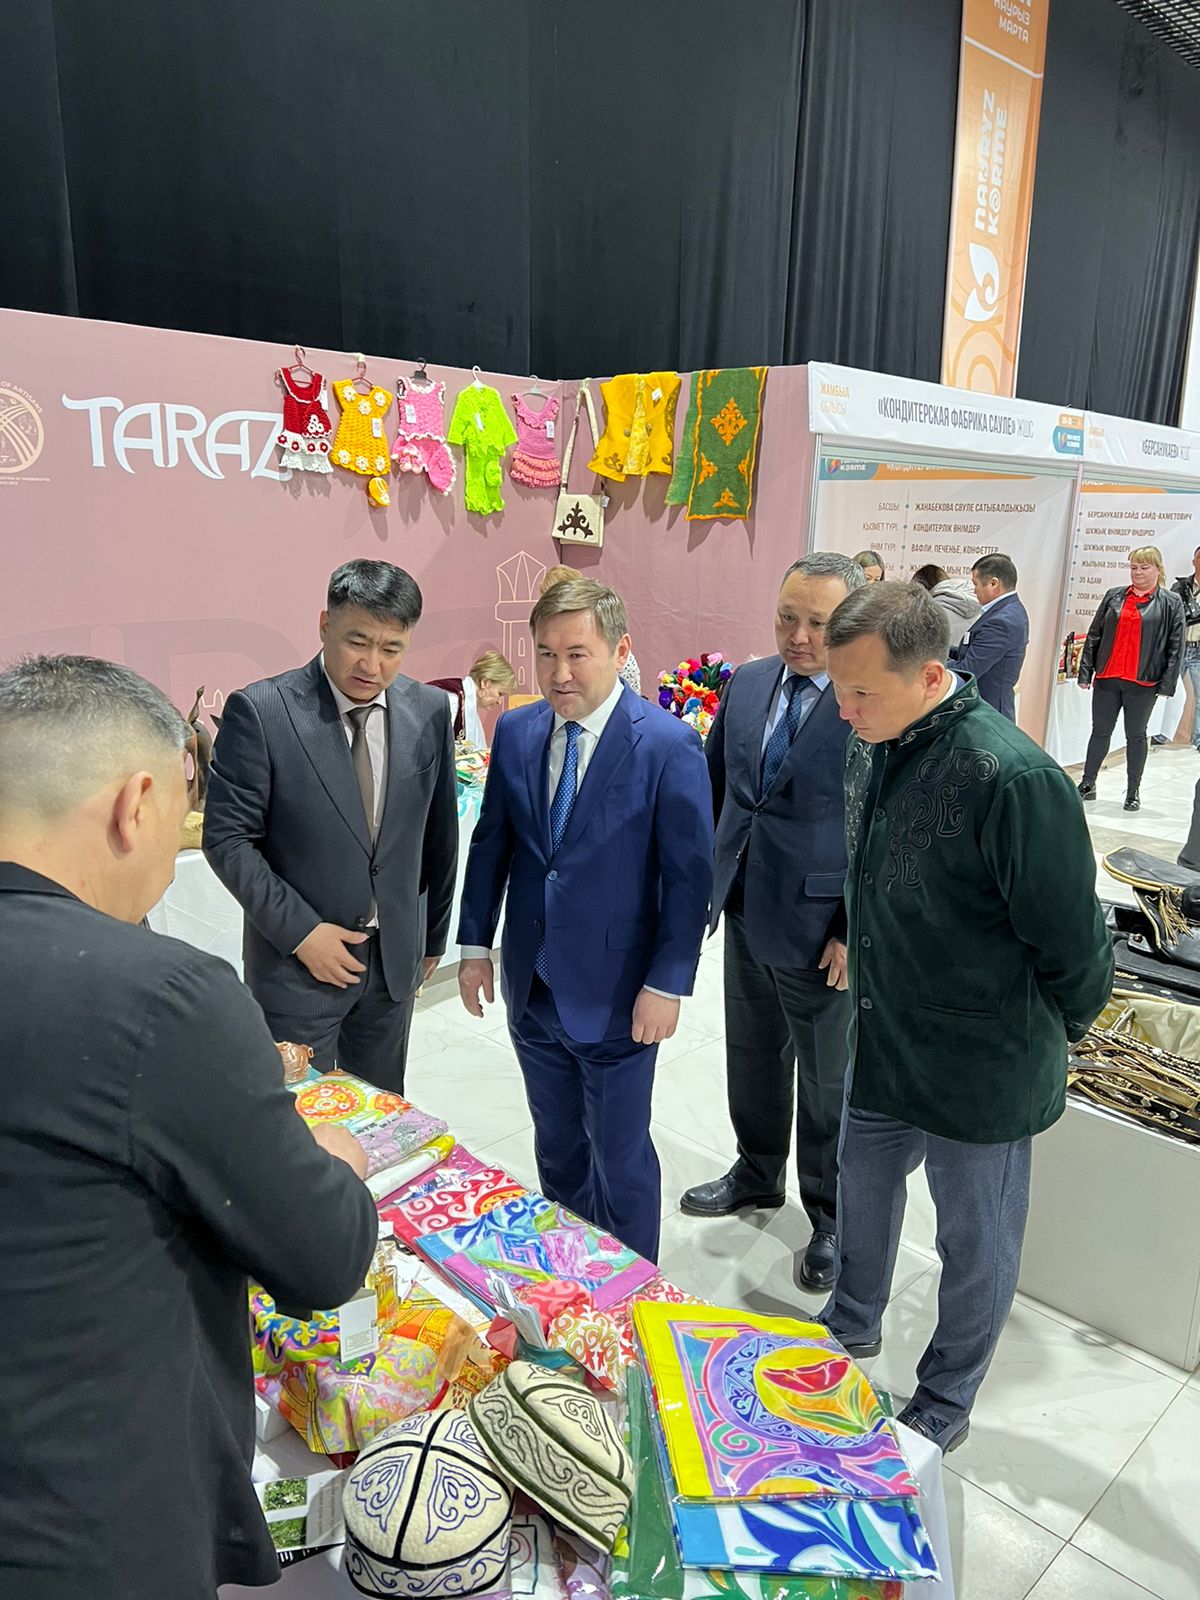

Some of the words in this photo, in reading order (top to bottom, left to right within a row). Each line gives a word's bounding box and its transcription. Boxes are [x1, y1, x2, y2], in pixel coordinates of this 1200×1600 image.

[998, 14, 1029, 44] МАРТА
[878, 396, 950, 427] «КОНДИТЕРСКАЯ
[950, 408, 988, 433] ФАБРИКА
[62, 393, 293, 482] TARAZ
